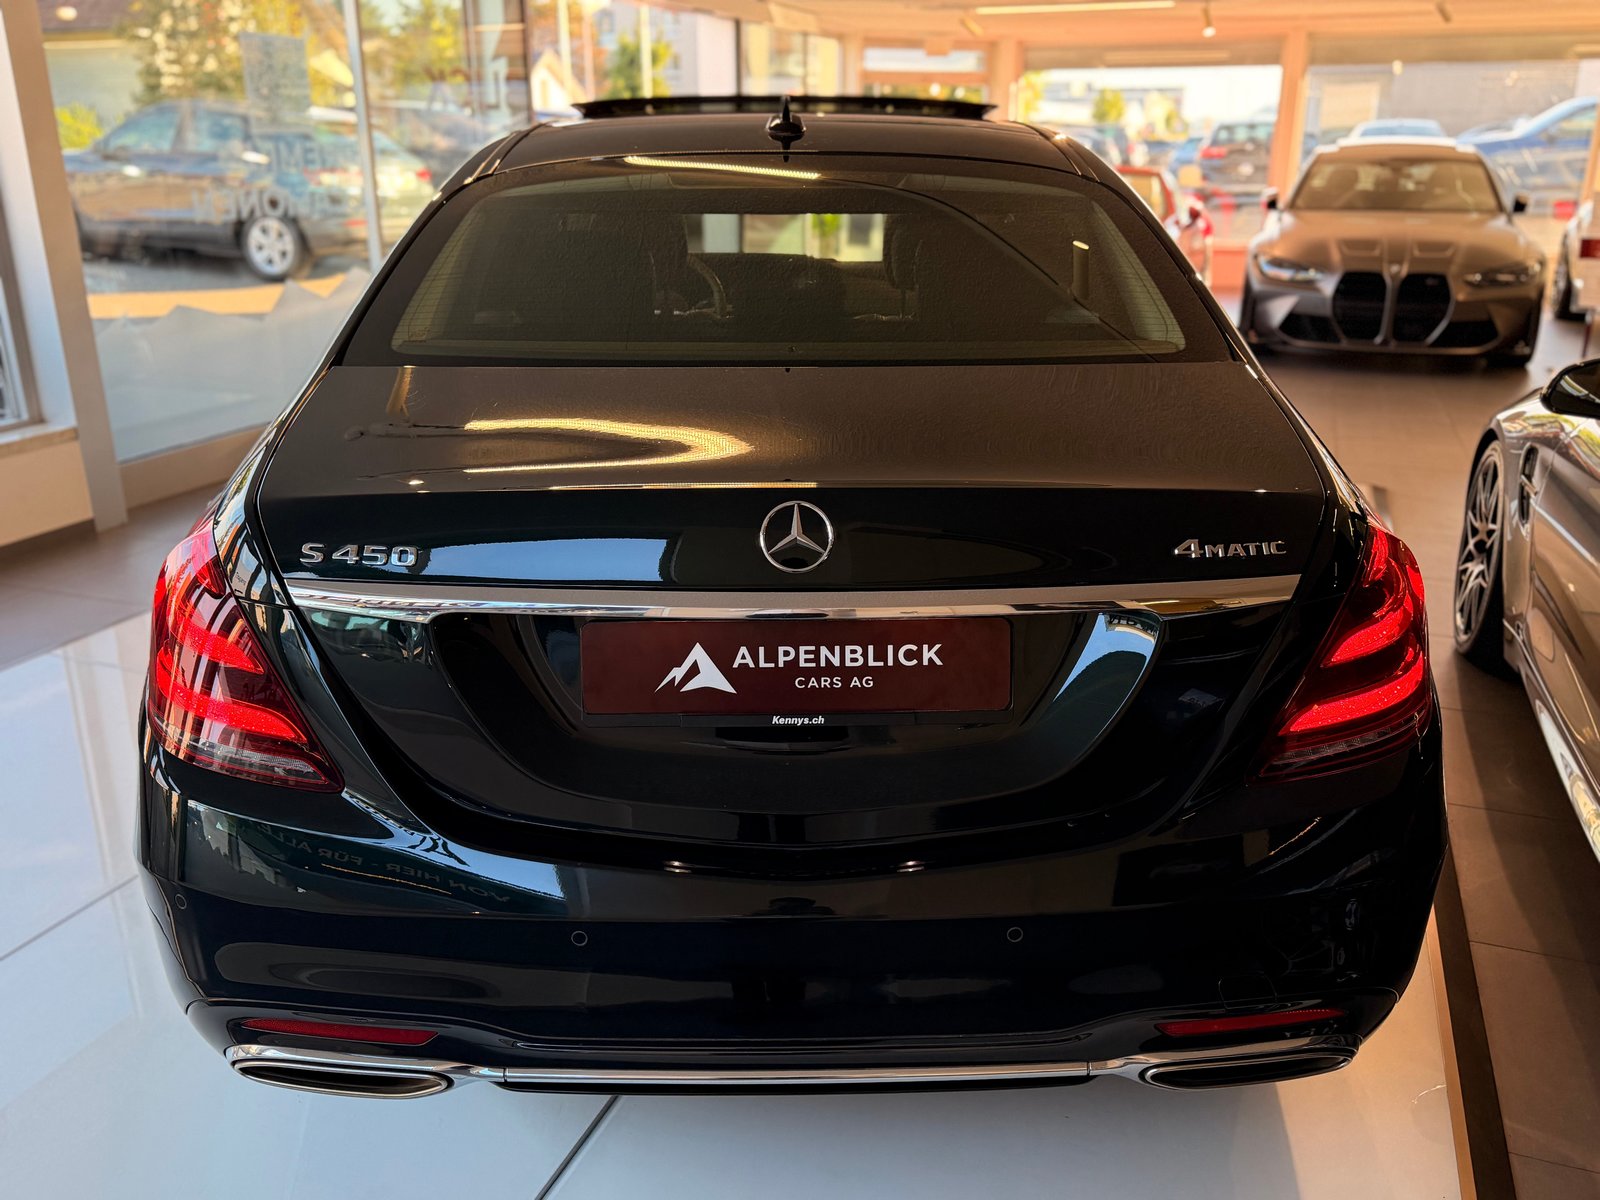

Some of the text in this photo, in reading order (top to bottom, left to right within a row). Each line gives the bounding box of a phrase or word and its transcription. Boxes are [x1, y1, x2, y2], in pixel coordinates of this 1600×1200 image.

[299, 542, 418, 567] S 450
[1174, 538, 1287, 558] 4MATIC
[732, 643, 943, 668] ALPENBLICK
[794, 676, 874, 689] CARS AG
[771, 715, 825, 726] Kennys.ch
